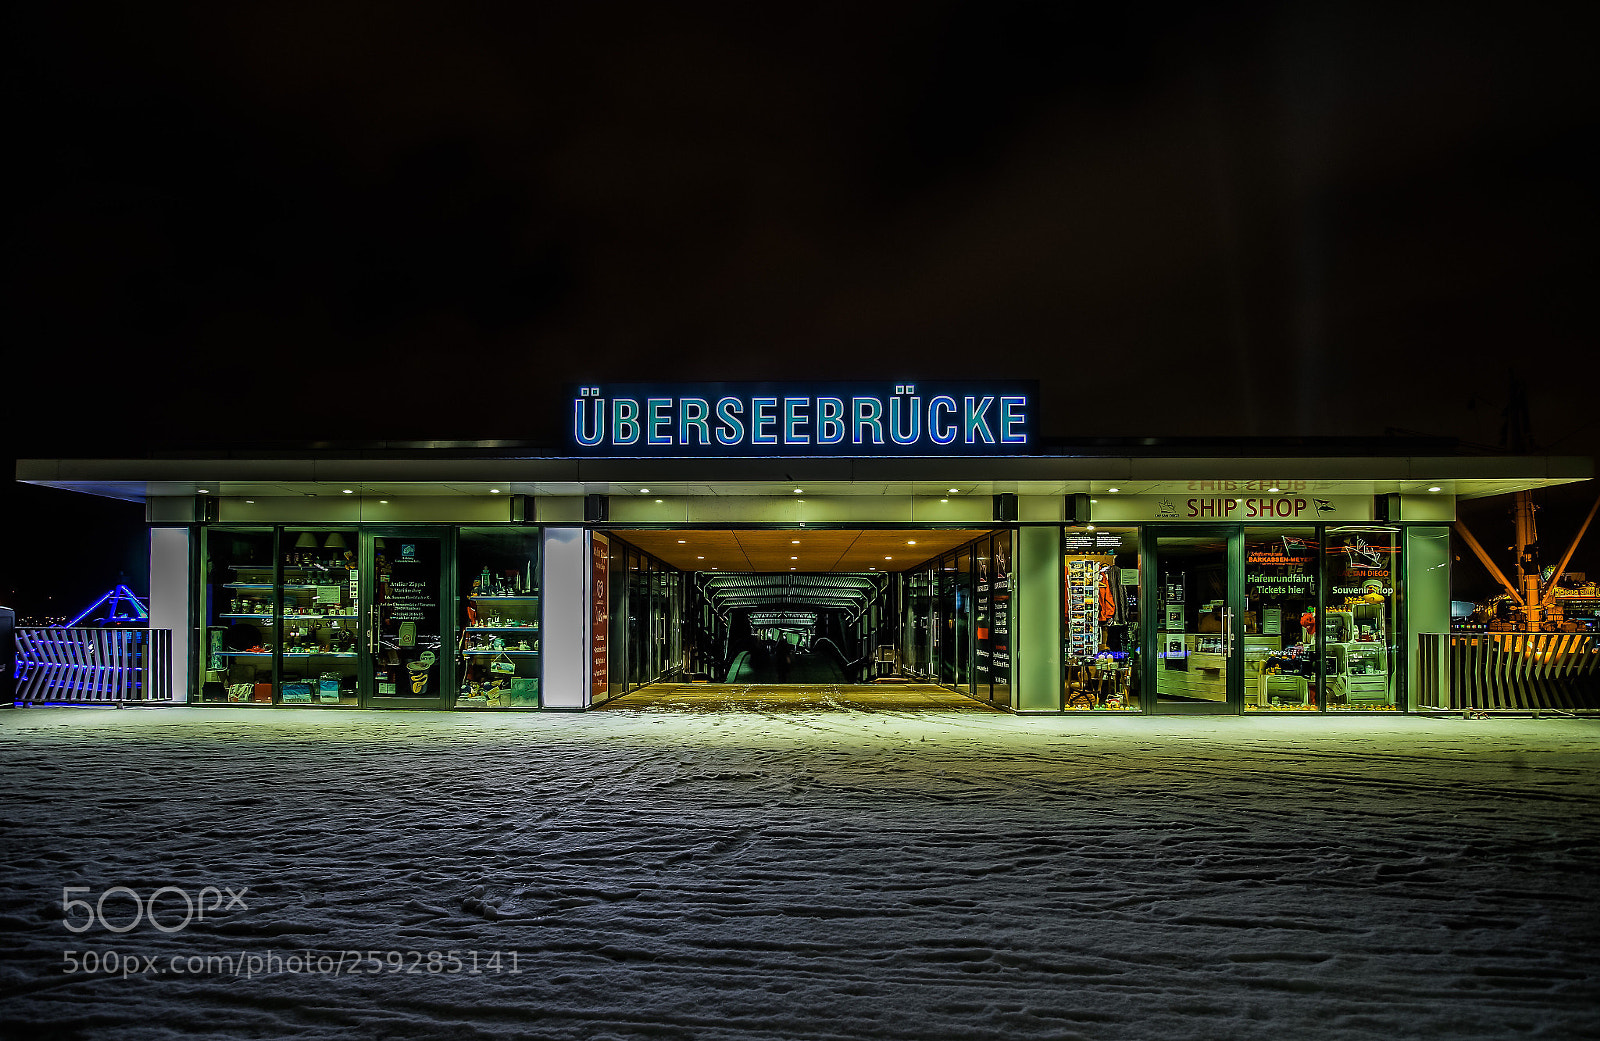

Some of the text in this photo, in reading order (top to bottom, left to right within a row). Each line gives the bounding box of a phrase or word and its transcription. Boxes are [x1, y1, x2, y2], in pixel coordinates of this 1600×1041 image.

[575, 385, 1027, 446] ÜBERSEEBRÜCKE
[1187, 498, 1307, 517] SHIP SHOP
[1247, 574, 1315, 583] Hafenrundfahrt
[1256, 585, 1305, 594] Tickets hier
